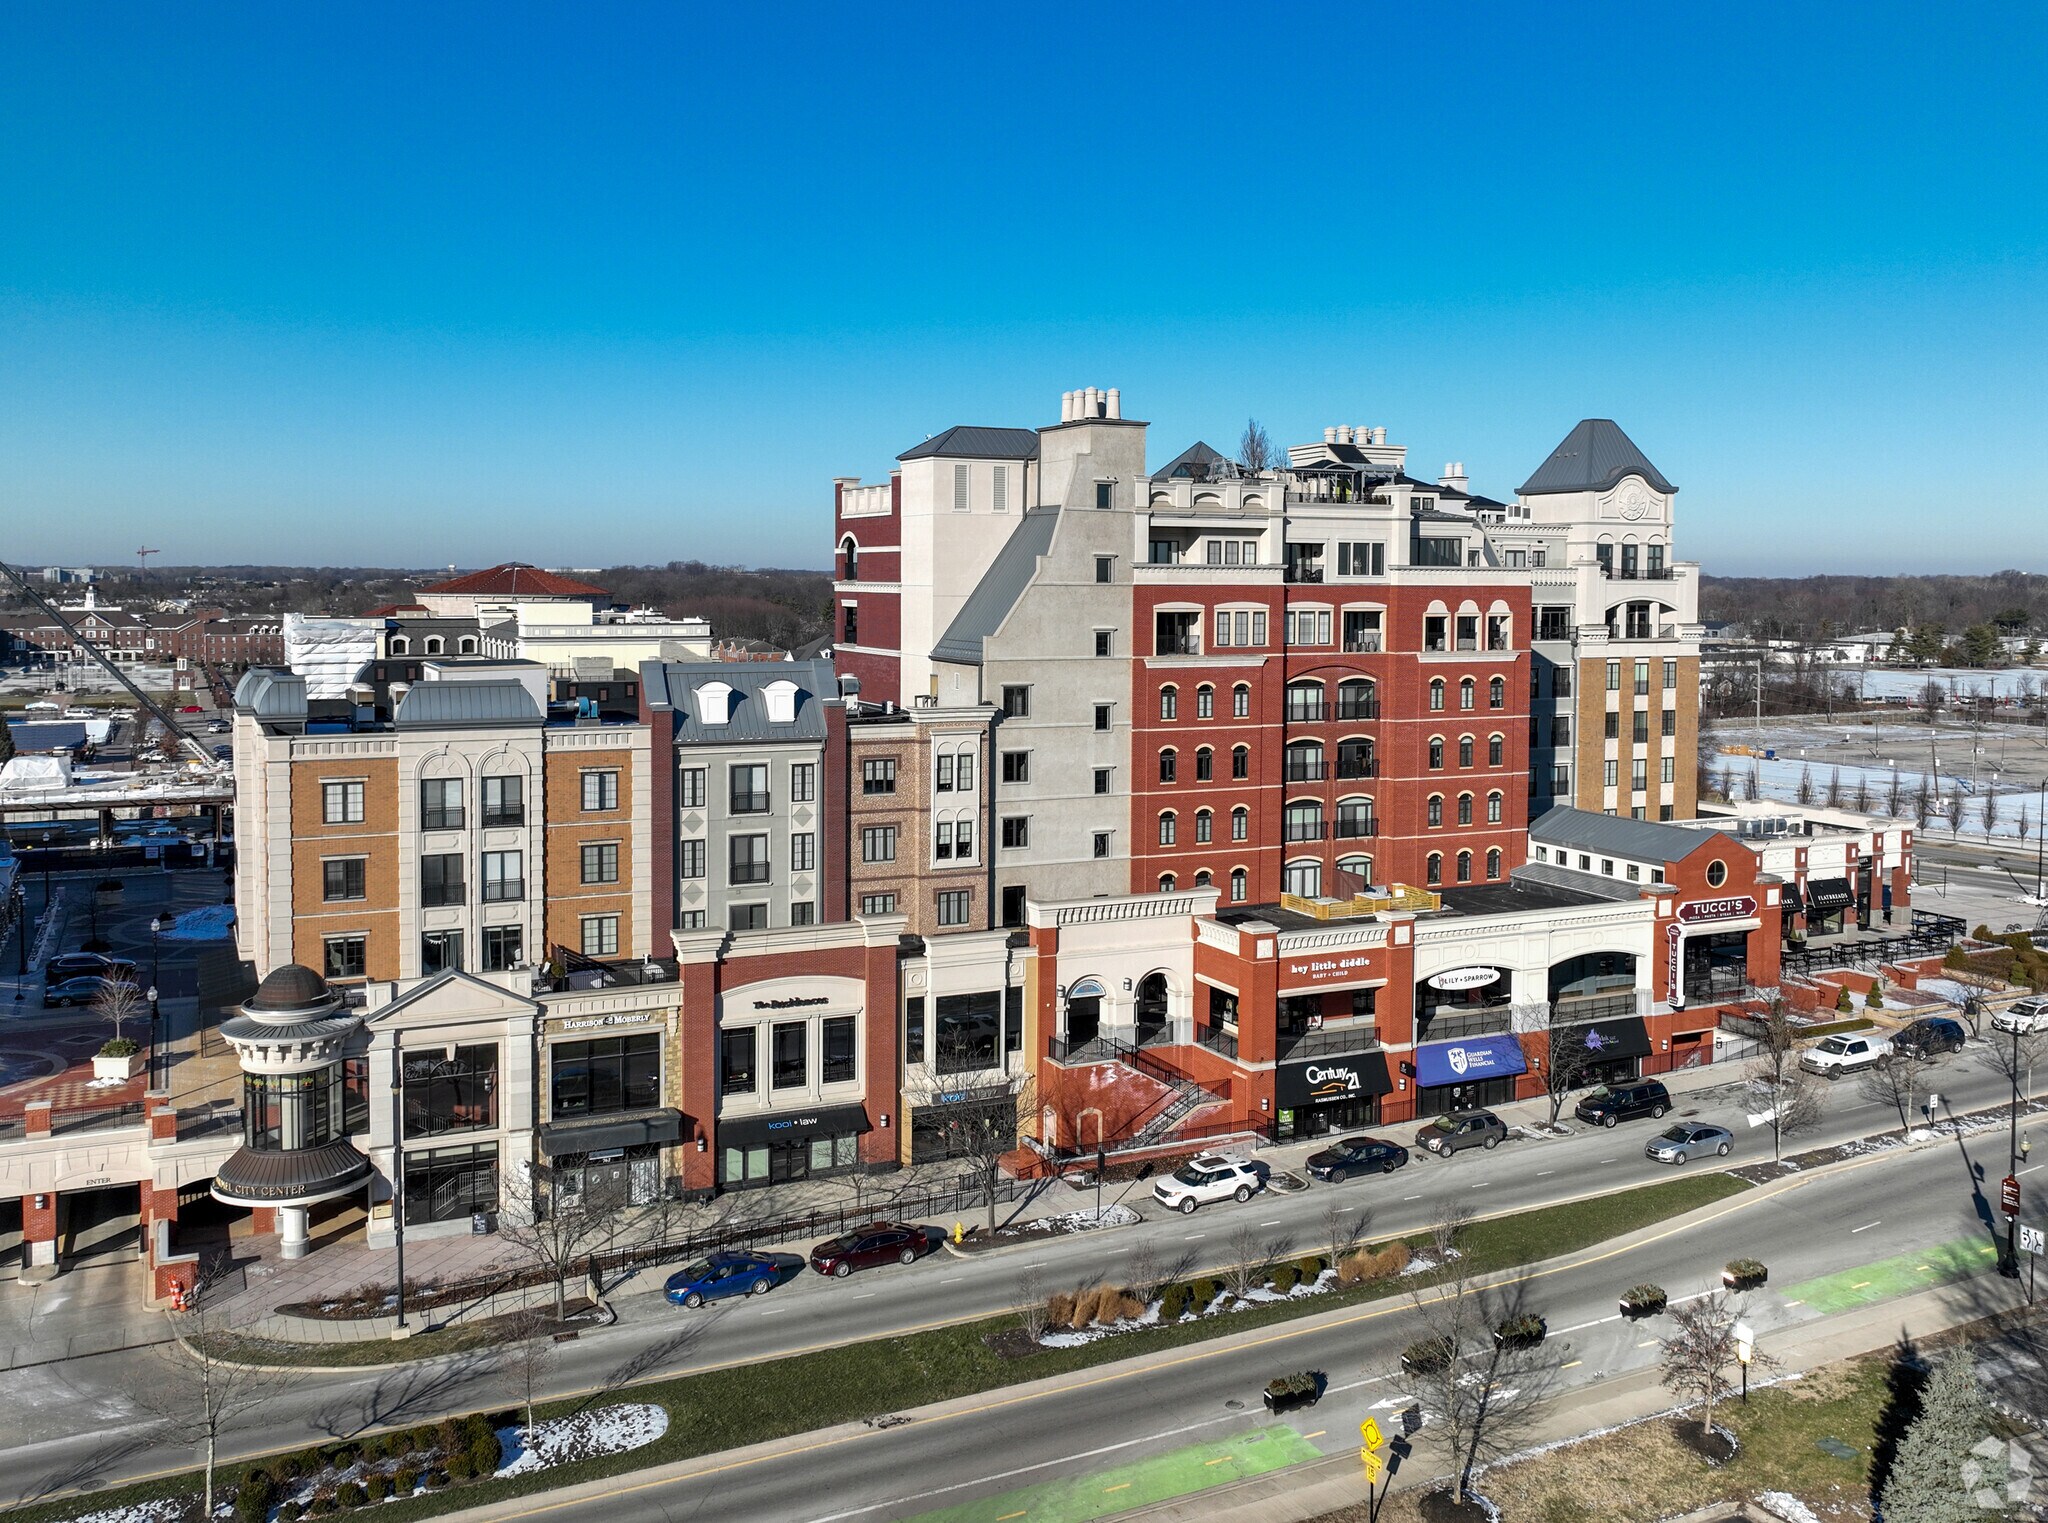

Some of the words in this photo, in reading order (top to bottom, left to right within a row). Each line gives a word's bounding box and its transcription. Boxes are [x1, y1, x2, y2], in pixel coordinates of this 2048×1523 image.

[1817, 892, 1848, 901] FLATBREADS
[1693, 900, 1743, 914] TUCCI'S
[1291, 964, 1309, 975] hey
[1311, 960, 1337, 971] little
[1339, 957, 1370, 968] diddle
[1464, 974, 1494, 982] SPARROW
[563, 1018, 604, 1029] HARRISON
[614, 1014, 651, 1024] MOBERLY
[1469, 1060, 1495, 1068] FINANCIAL
[1306, 1066, 1348, 1084] Century
[1315, 1095, 1340, 1103] RASMUSSEN
[799, 1118, 818, 1126] law
[86, 1177, 111, 1185] ENTER
[235, 1185, 257, 1195] CITY
[261, 1184, 306, 1197] CENTER
